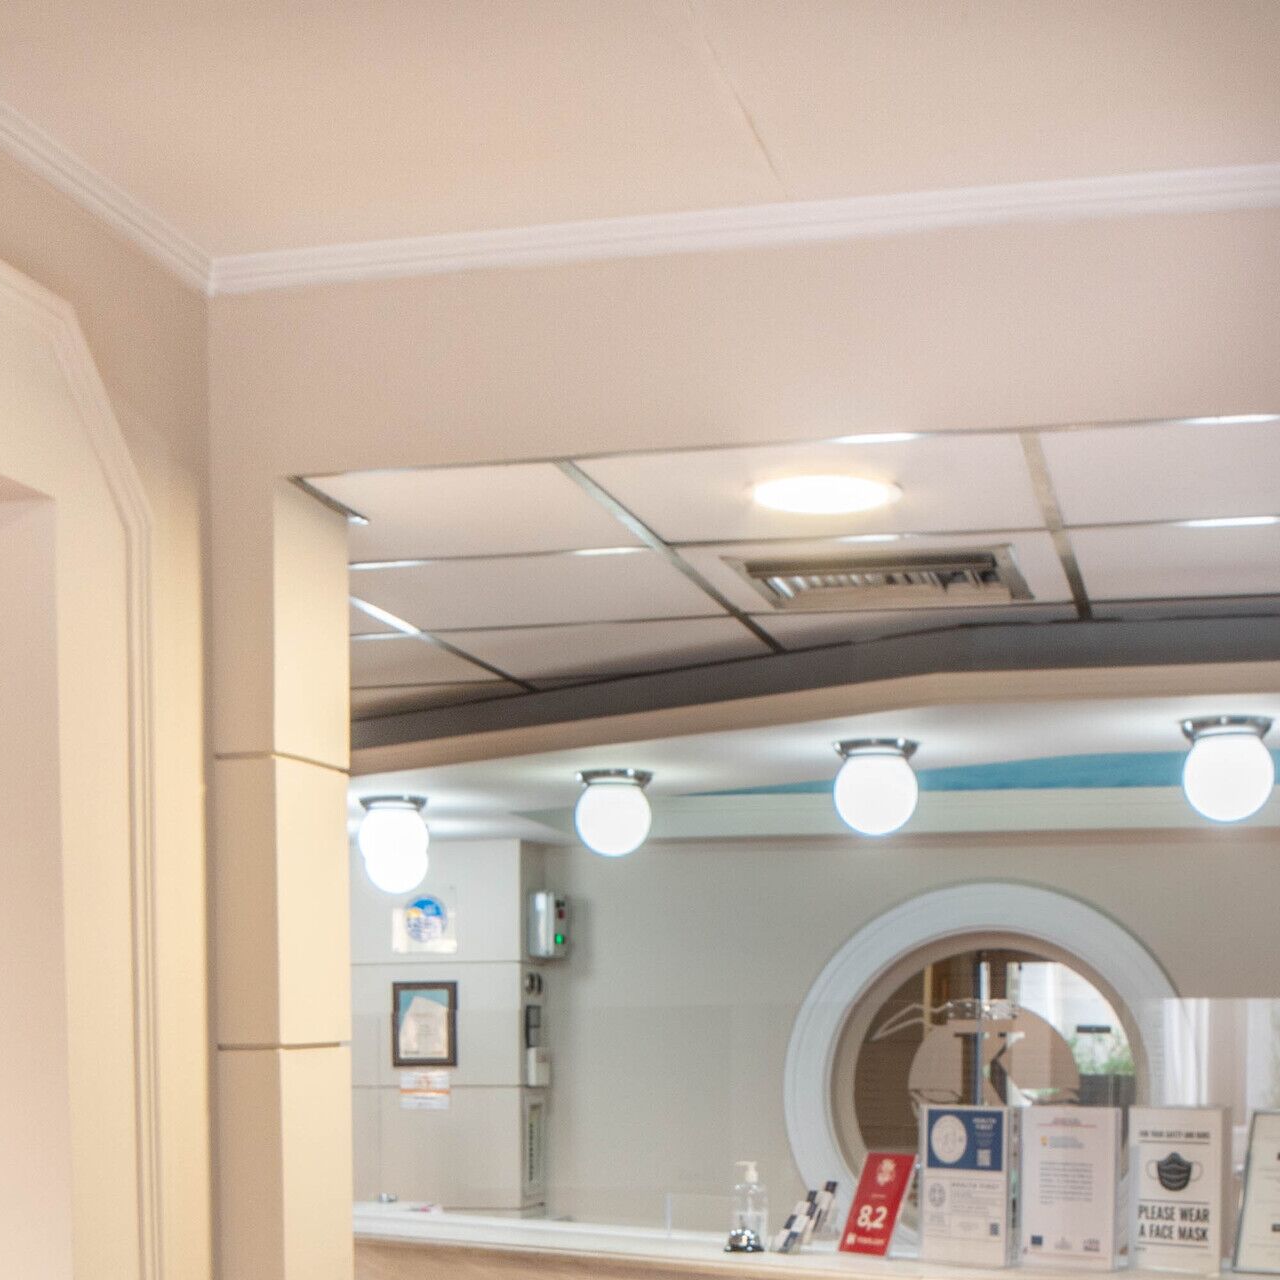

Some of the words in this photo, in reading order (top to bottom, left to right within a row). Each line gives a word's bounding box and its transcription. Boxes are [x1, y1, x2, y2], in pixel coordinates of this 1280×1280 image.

[857, 1204, 888, 1232] 8,2
[1137, 1205, 1175, 1221] PLEASE
[1178, 1206, 1210, 1223] WEAR
[1138, 1223, 1147, 1237] A
[1148, 1224, 1174, 1240] FACE
[1178, 1226, 1209, 1242] MASK
